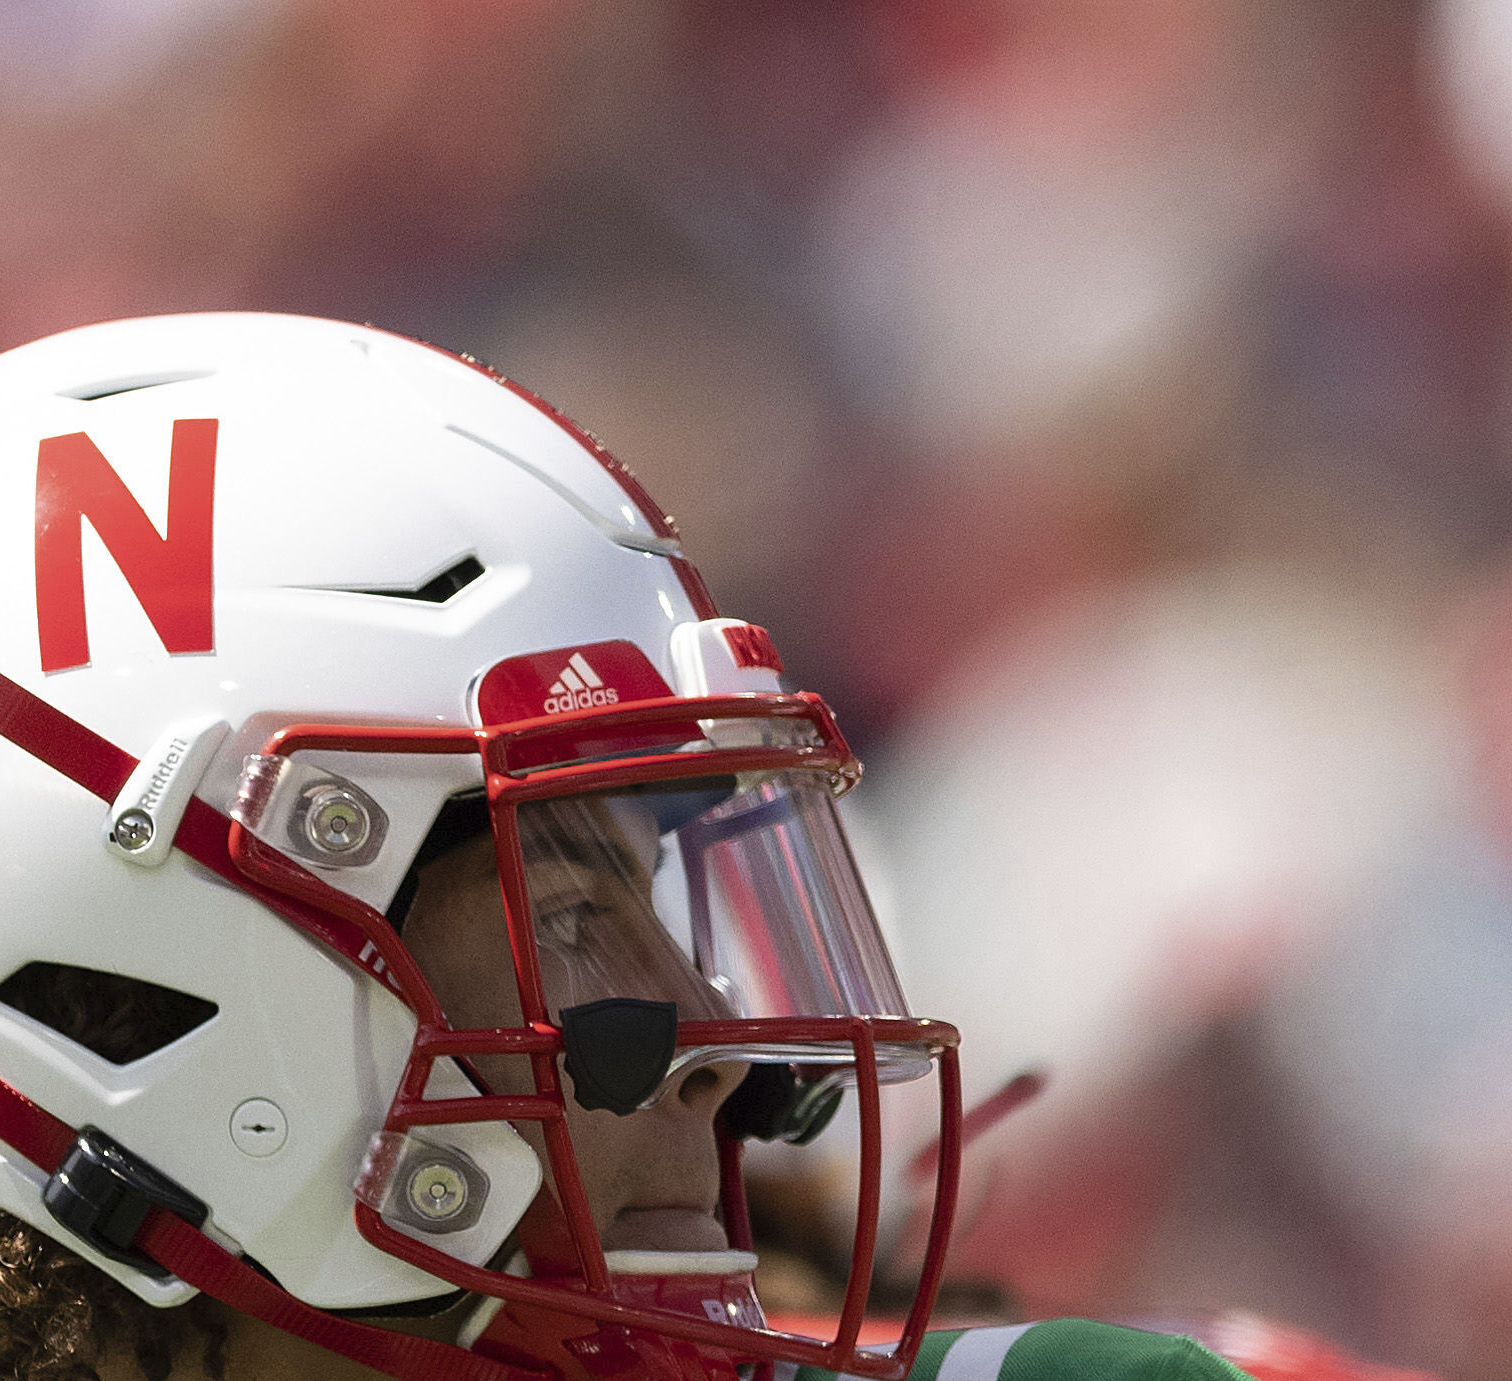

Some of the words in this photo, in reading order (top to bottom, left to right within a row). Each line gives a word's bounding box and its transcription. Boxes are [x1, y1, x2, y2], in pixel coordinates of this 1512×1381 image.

[34, 417, 220, 674] N
[544, 687, 619, 714] adidas
[140, 737, 188, 811] Riddell
